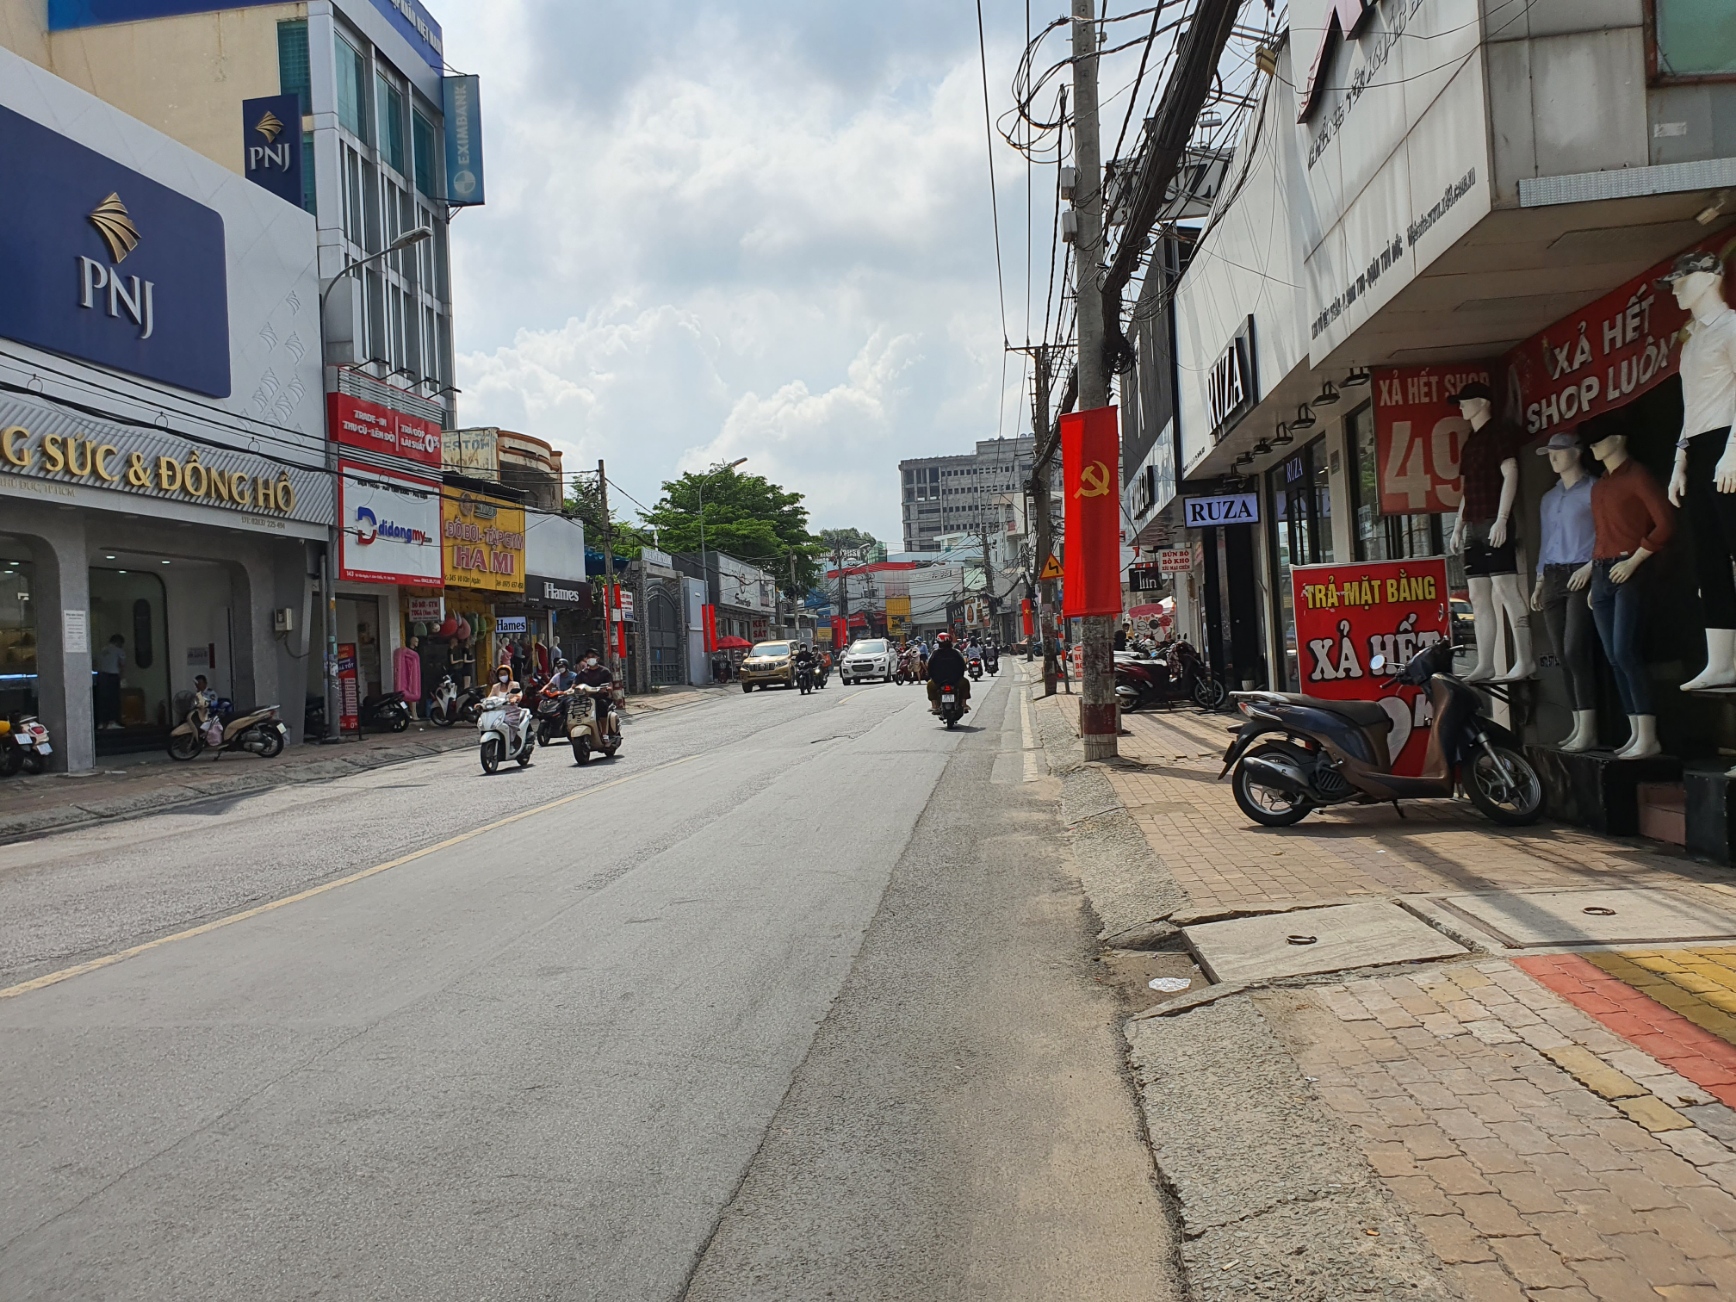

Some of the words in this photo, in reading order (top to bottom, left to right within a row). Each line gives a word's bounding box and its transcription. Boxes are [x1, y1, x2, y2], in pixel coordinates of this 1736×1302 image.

[455, 84, 469, 164] EXIMBANK
[249, 143, 290, 172] PNJ
[80, 255, 154, 339] PNJ
[1552, 320, 1593, 381] XẢ
[1602, 283, 1655, 356] HẾT
[1207, 337, 1245, 435] RUZA
[1379, 369, 1403, 407] XẢ
[1407, 367, 1439, 404] HẾT
[1526, 375, 1600, 434] SHOP
[1607, 330, 1680, 401] LUÔN
[425, 434, 440, 453] 0%
[41, 431, 120, 481] SỨC
[127, 451, 152, 488] &
[157, 450, 250, 505] ĐỒNG
[254, 470, 297, 513] HỒ
[446, 515, 463, 540] ĐỒ
[1190, 499, 1253, 523] RUZA
[453, 545, 488, 572] HA
[490, 550, 516, 576] MI
[543, 581, 580, 602] Hames
[1304, 575, 1339, 609] TRẢ
[1343, 575, 1381, 610] MẶT
[1386, 569, 1437, 604] BẰNG
[496, 618, 526, 631] Hames
[1309, 619, 1364, 680] XẢ
